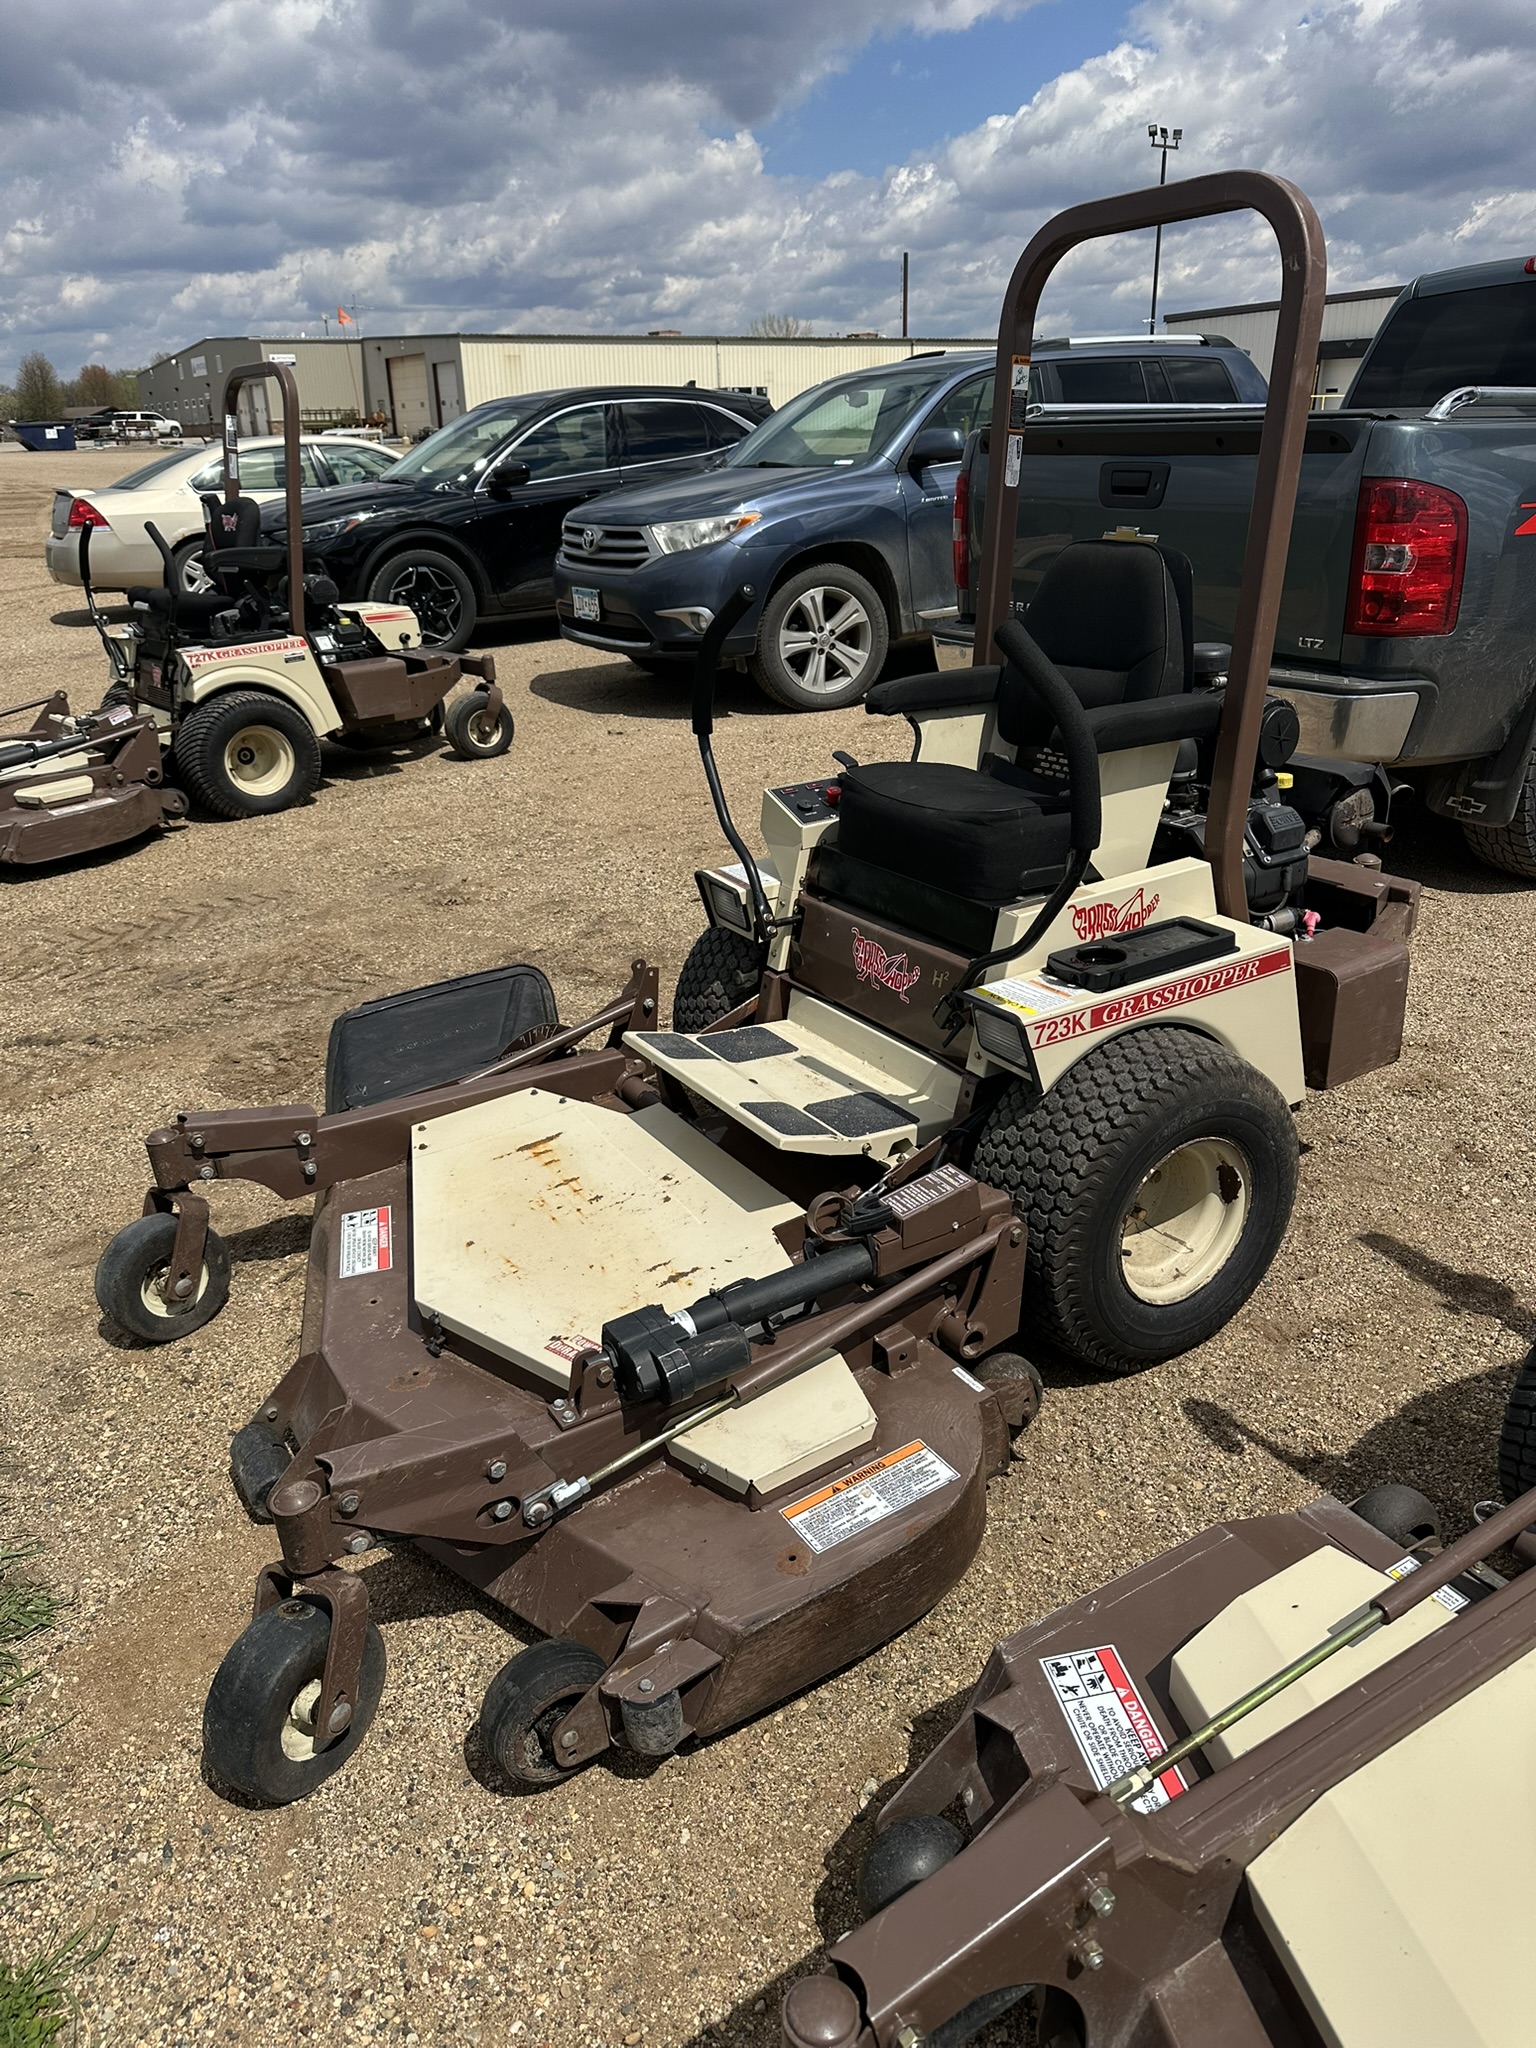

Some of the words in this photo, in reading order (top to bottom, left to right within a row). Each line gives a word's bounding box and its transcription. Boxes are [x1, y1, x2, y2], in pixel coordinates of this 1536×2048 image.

[187, 651, 216, 664] 727K
[220, 640, 302, 659] GRASSHOPPER
[1299, 636, 1325, 650] LTZ
[1034, 1012, 1087, 1045] 723K
[1102, 960, 1260, 1024] GRASSHOPPER
[842, 1461, 887, 1487] WARNING
[1072, 1708, 1086, 1728] CHUTE
[1083, 1730, 1092, 1740] OR
[1088, 1742, 1100, 1756] SIDE
[1077, 1700, 1091, 1720] NEVER
[1088, 1722, 1106, 1750] OPERATE
[1102, 1752, 1120, 1779] WITHOU
[1097, 1705, 1112, 1726] DEATH
[1108, 1728, 1122, 1747] FROM
[1118, 1749, 1134, 1771] THRO
[1098, 1724, 1107, 1734] OR
[1103, 1736, 1118, 1757] BLADE
[1106, 1707, 1116, 1716] TO
[1112, 1718, 1127, 1738] AVOID
[1124, 1700, 1163, 1757] DANGER
[1125, 1728, 1141, 1748] KEEP
[1136, 1751, 1150, 1765] AW
